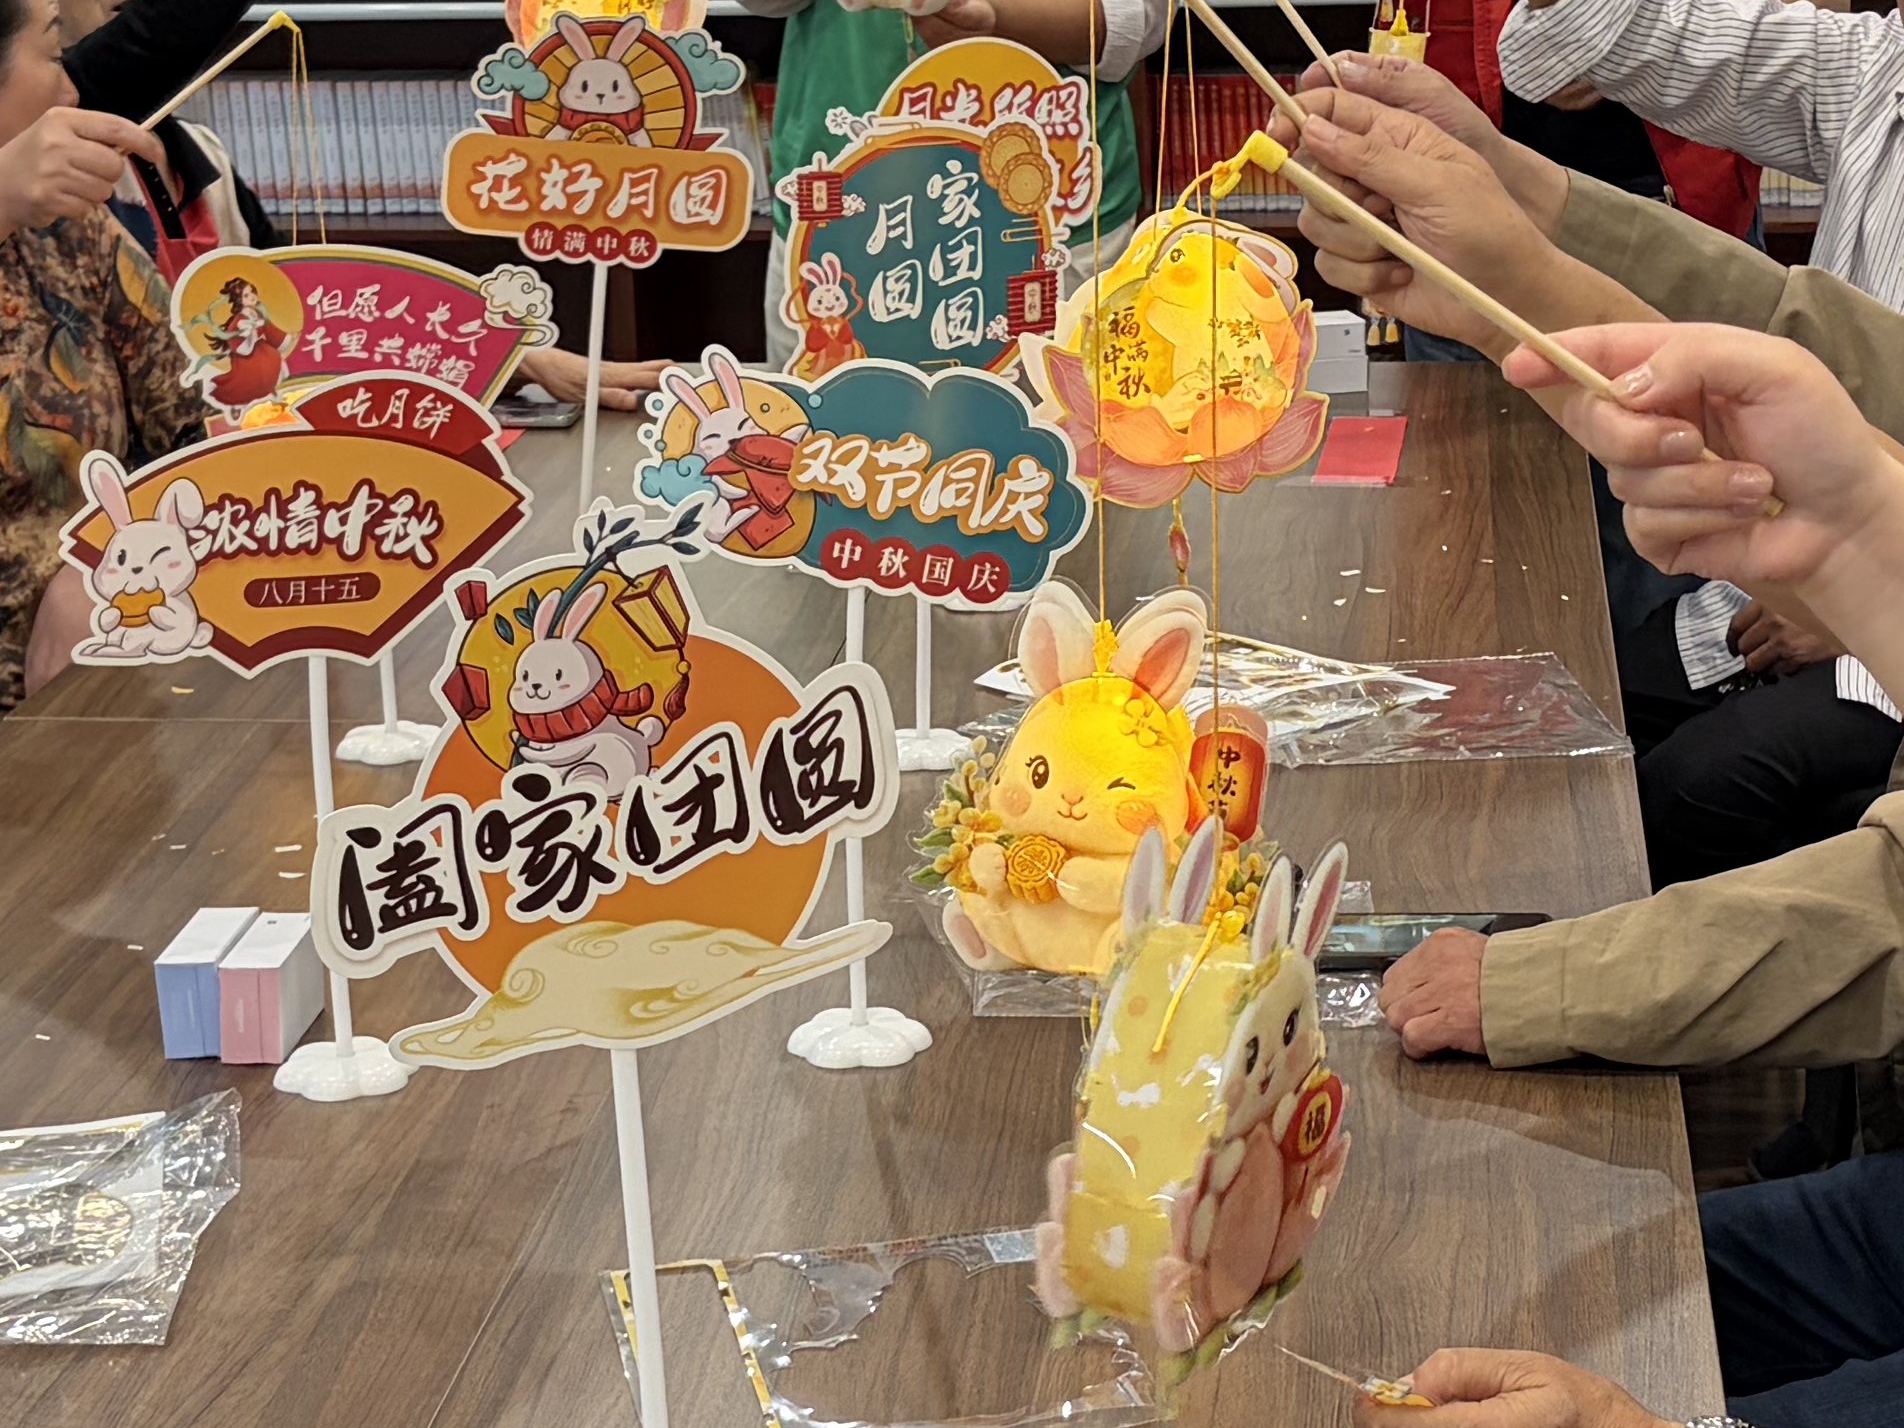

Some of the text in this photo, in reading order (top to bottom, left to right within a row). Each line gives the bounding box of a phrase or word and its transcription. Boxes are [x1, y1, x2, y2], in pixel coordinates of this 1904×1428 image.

[470, 152, 728, 226] 花好月圆
[531, 228, 652, 258] 情满中秋
[865, 195, 924, 323] 月圆
[926, 160, 984, 350] 家团圆
[306, 284, 488, 356] 但愿人长久
[301, 326, 476, 388] 千里共婵娟
[336, 387, 454, 440] 吃月饼
[796, 436, 1052, 538] 双节同庆
[191, 484, 440, 564] 浓情中秋
[258, 577, 362, 605] 八月十五
[832, 538, 1001, 594] 中秋国庆
[337, 685, 875, 951] 阖家团圆
[1304, 1102, 1326, 1145] 福
